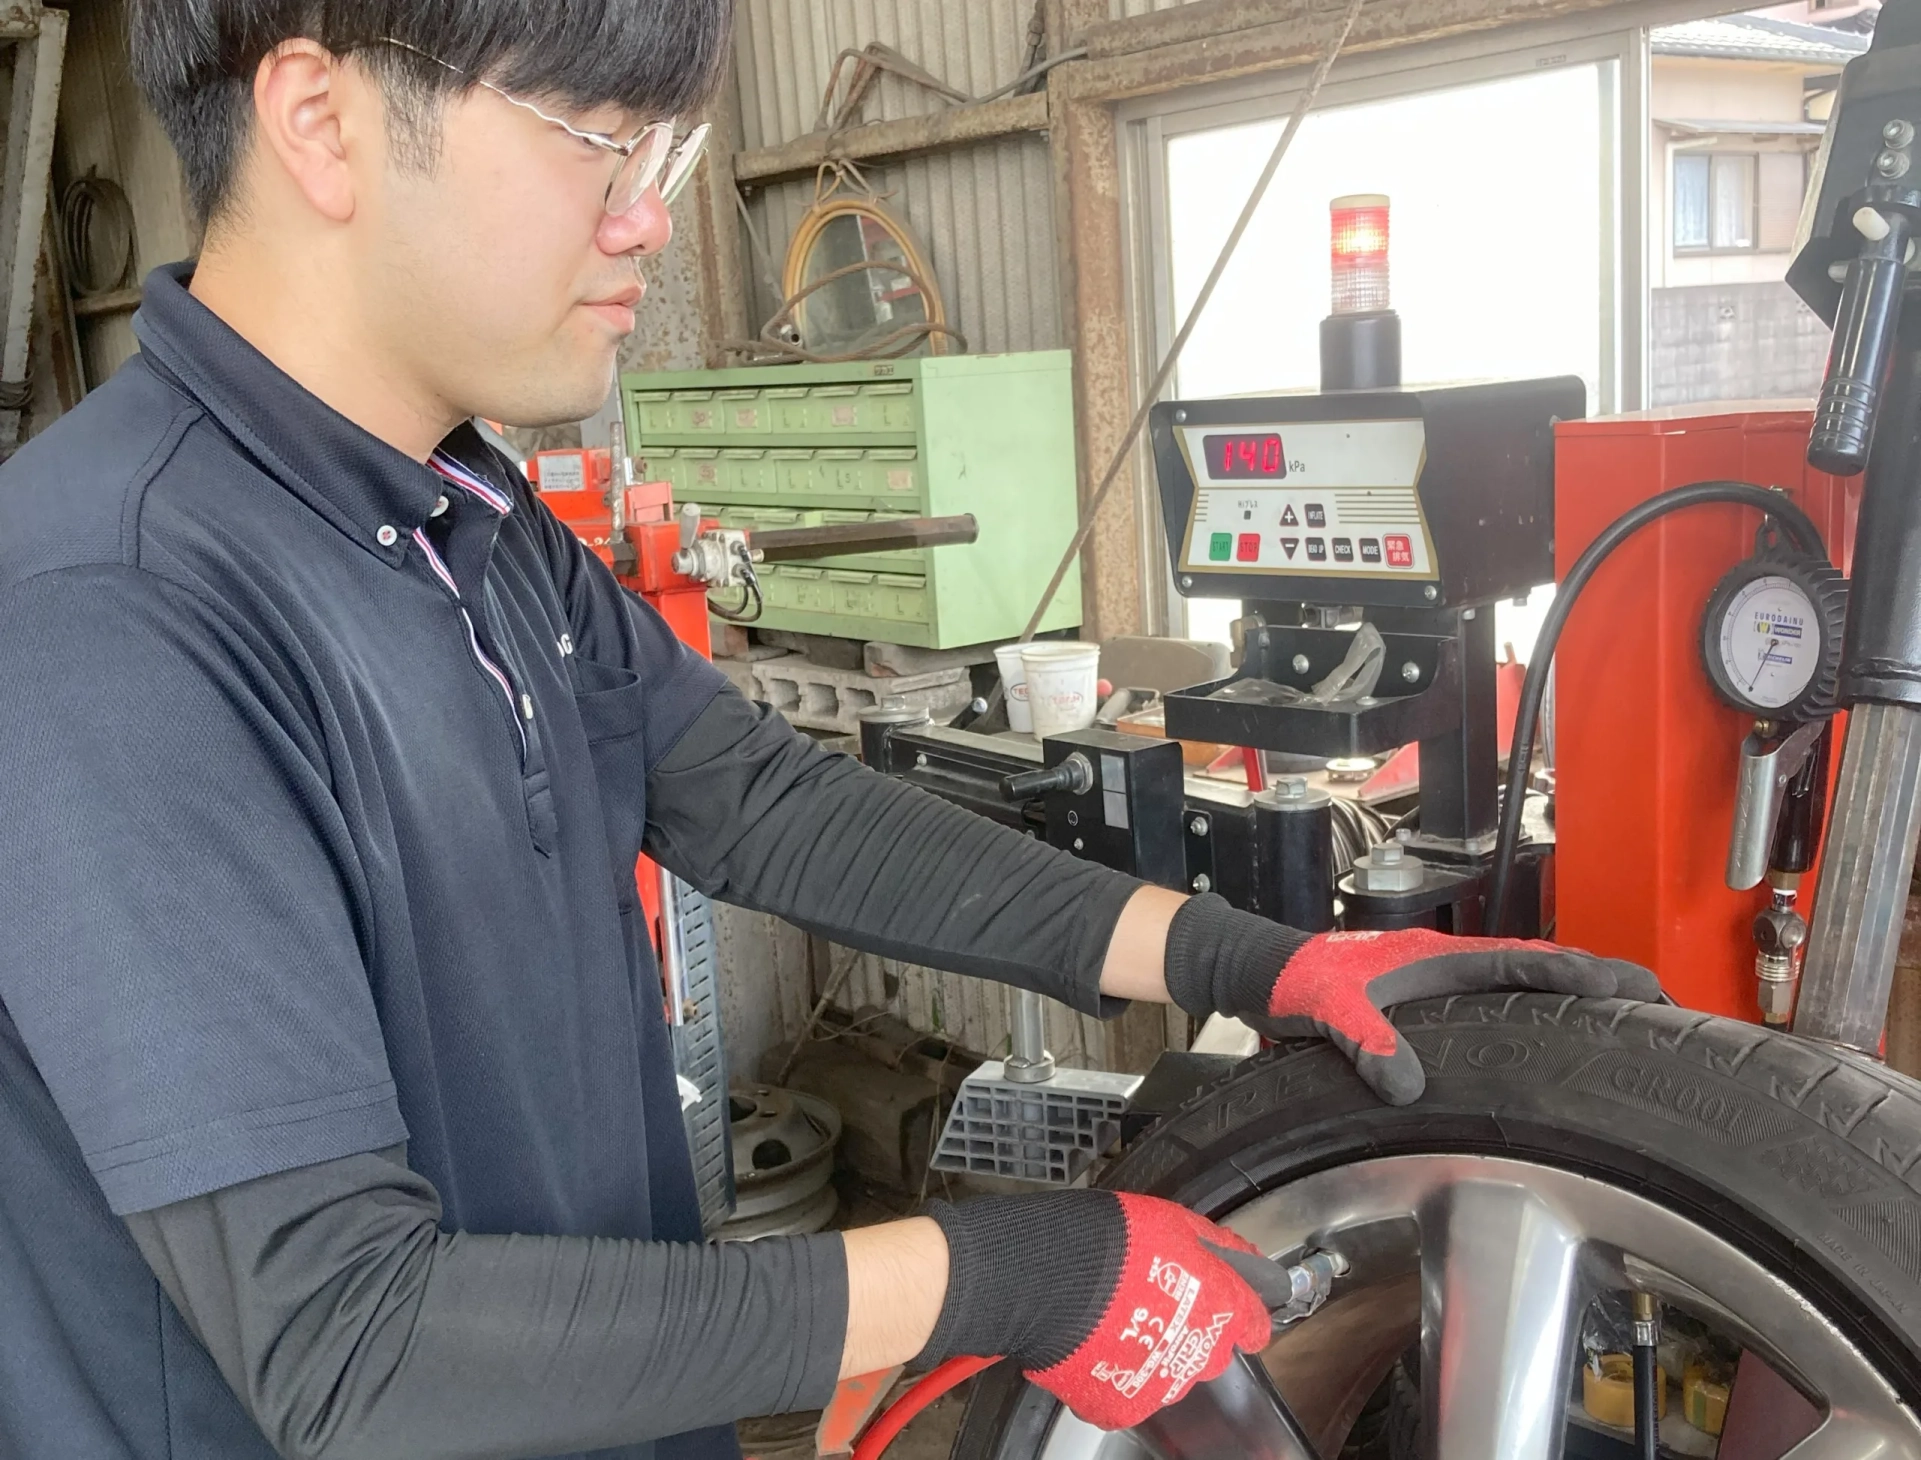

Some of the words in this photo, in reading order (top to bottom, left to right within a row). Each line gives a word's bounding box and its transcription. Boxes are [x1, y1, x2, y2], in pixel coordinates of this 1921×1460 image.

[1225, 438, 1280, 472] 140
[1288, 460, 1306, 473] kPa
[1212, 541, 1229, 552] START
[1240, 541, 1257, 553] STOP
[1335, 545, 1351, 555] CHECK
[1362, 545, 1379, 555] MODE
[1386, 540, 1404, 550] 緊急
[1392, 552, 1410, 562] 排気
[1169, 1288, 1195, 1334] LATEX
[1169, 1328, 1203, 1378] GRIP
[1132, 1351, 1163, 1388] WG-300
